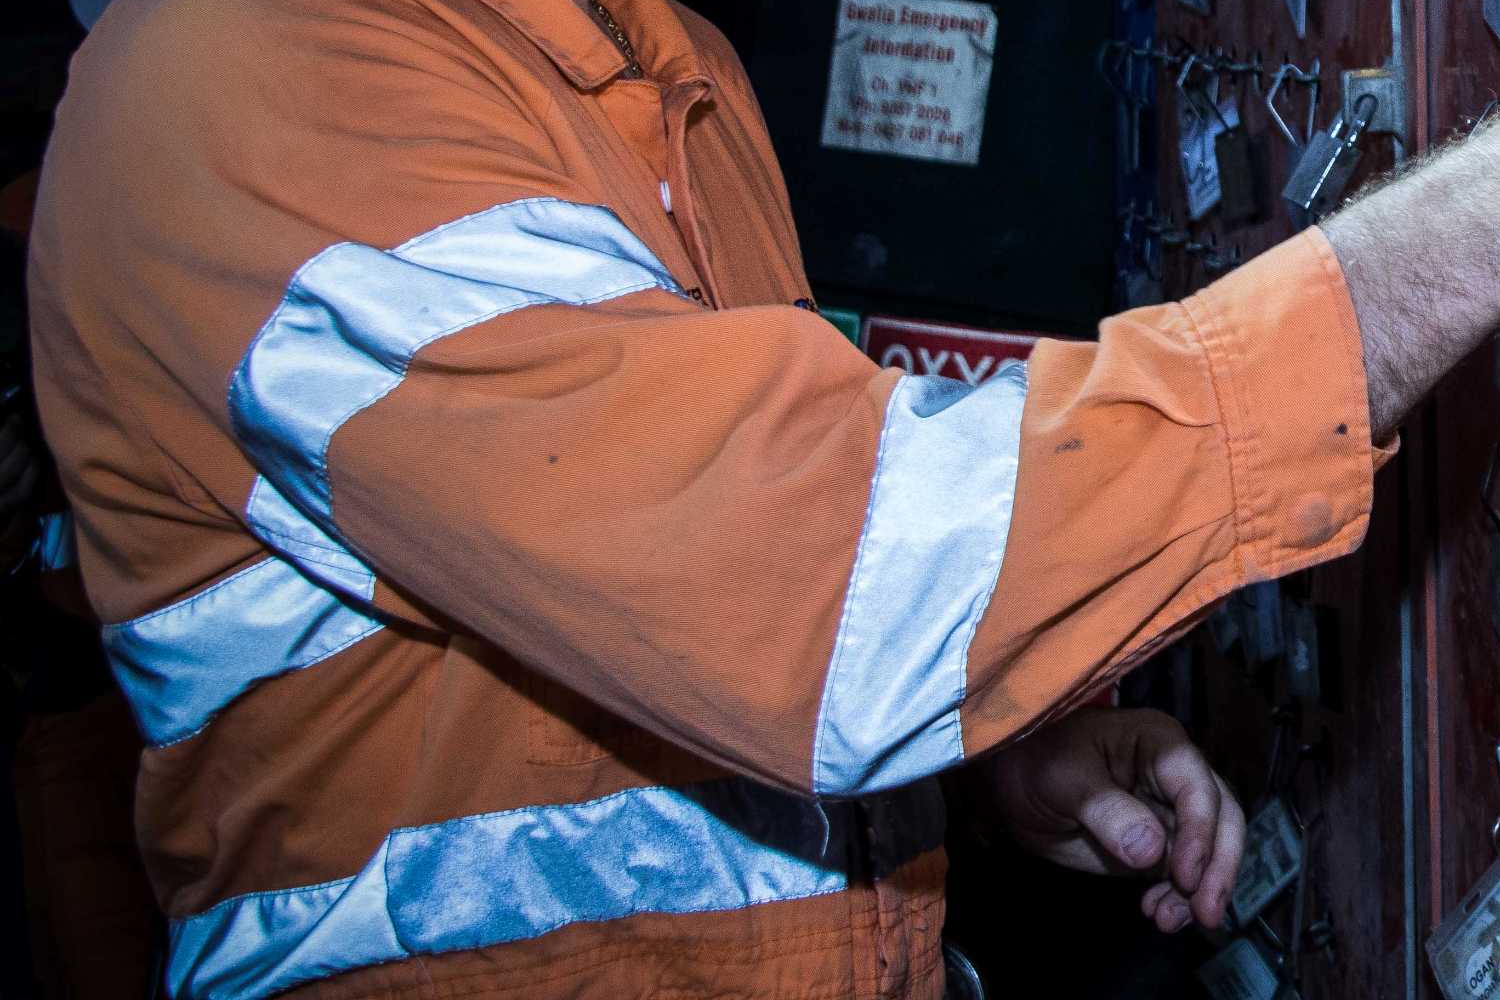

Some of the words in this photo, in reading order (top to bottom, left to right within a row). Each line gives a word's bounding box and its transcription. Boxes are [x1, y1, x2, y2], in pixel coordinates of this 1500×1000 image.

[901, 5, 988, 39] Emergency
[863, 36, 955, 63] Information
[881, 344, 995, 386] OXY
